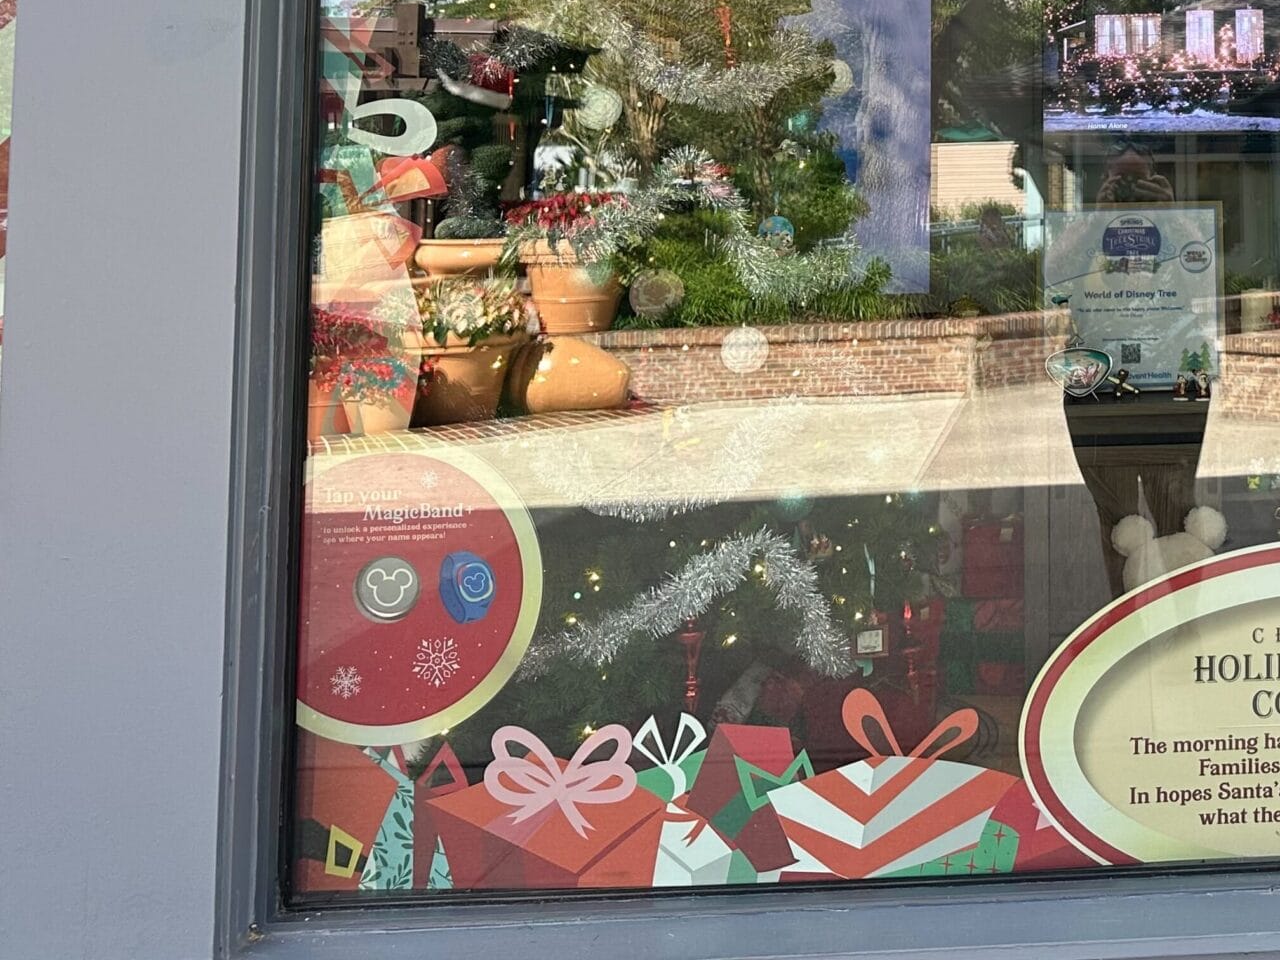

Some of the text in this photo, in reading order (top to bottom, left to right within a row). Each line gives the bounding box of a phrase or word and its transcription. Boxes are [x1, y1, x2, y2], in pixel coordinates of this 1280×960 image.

[1084, 289, 1177, 300] World of Disney Tree
[323, 487, 402, 507] Tap your
[333, 525, 361, 534] unlock
[370, 523, 421, 534] personalized
[422, 522, 468, 531] experience
[338, 535, 365, 543] where
[365, 535, 387, 544] your
[387, 533, 410, 542] name
[412, 530, 446, 542] appears!
[1130, 737, 1168, 755] The
[1173, 735, 1259, 754] morning
[1199, 757, 1280, 777] Families
[1130, 787, 1150, 805] In
[1156, 786, 1213, 806] hopes
[1199, 808, 1248, 826] what
